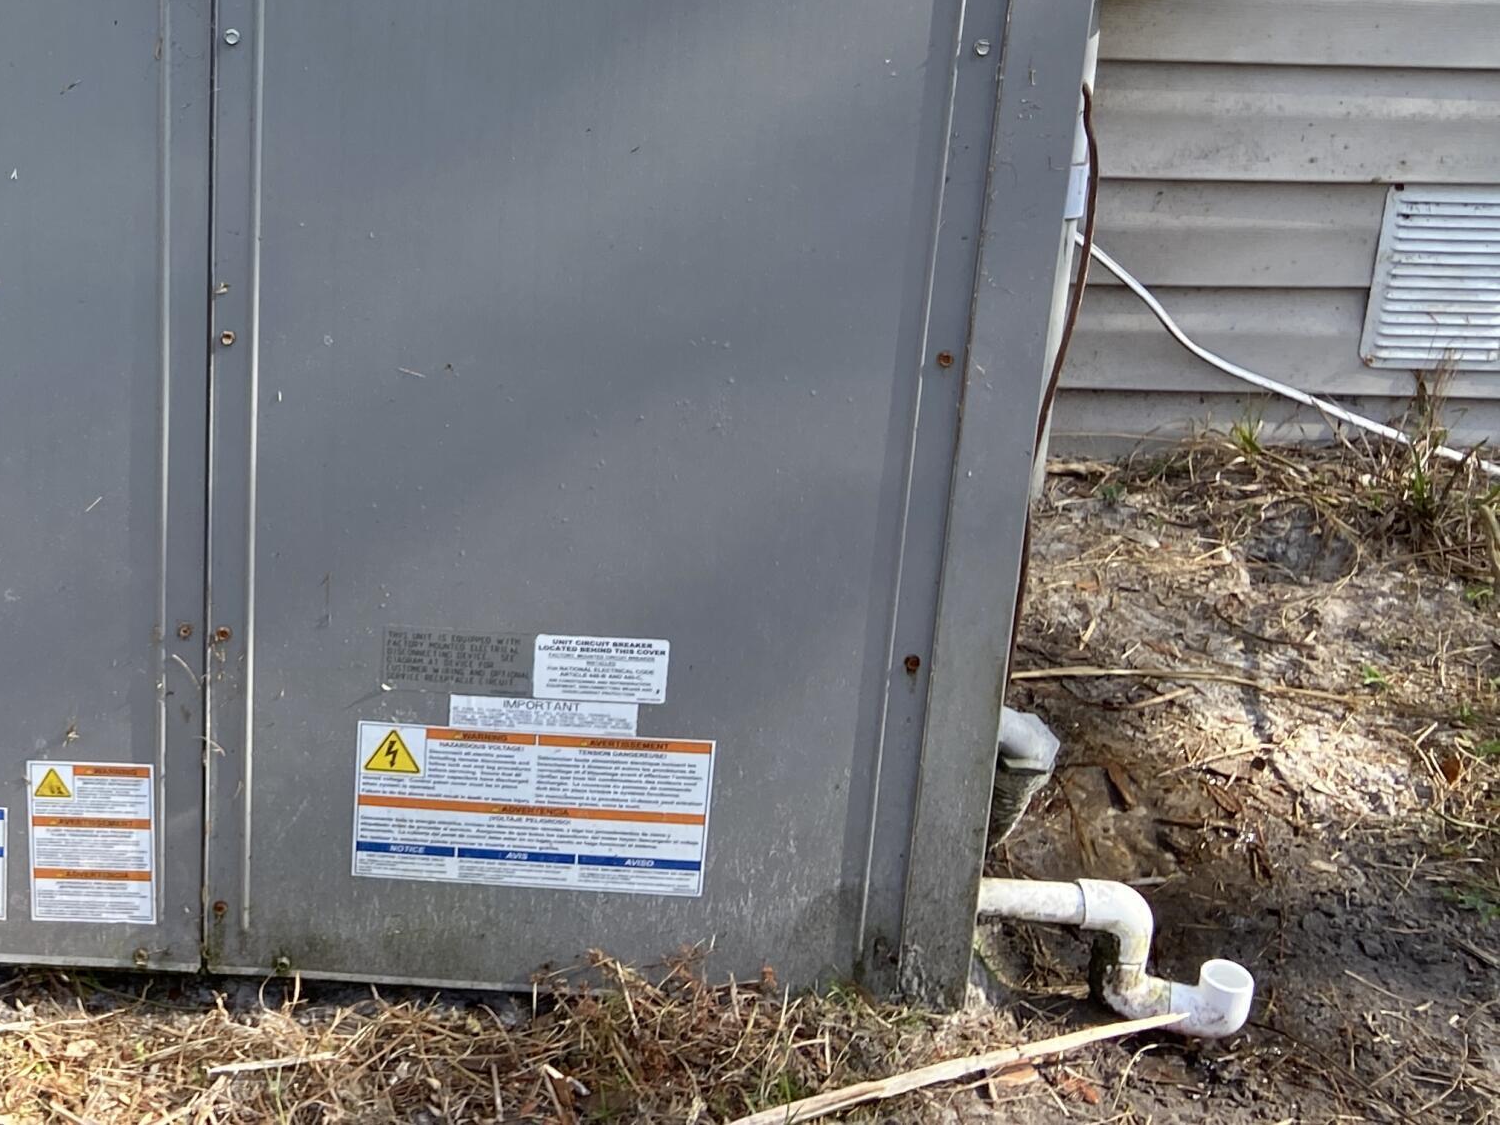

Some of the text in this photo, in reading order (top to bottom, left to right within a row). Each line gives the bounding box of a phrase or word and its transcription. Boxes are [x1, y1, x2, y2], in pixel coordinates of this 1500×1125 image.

[504, 699, 580, 711] IMPORTANT
[462, 733, 507, 741] WARNING
[590, 740, 669, 750] AVERTISSEMENT
[501, 806, 569, 816] ADVERTENCIA
[390, 845, 425, 853] NOTICE
[625, 859, 654, 867] AVISO
